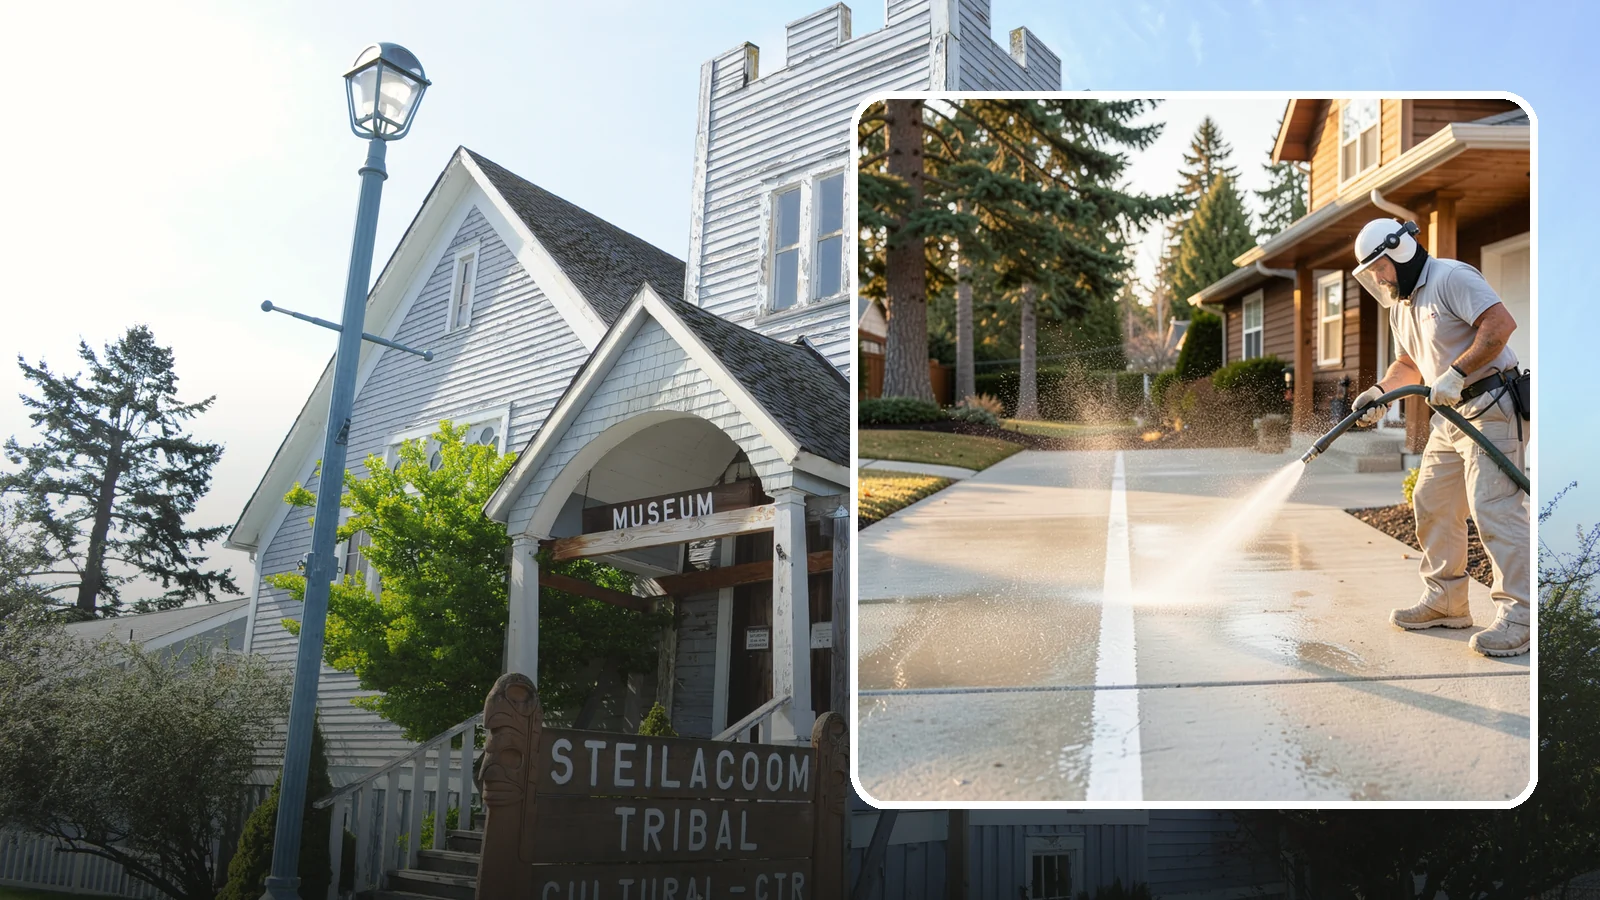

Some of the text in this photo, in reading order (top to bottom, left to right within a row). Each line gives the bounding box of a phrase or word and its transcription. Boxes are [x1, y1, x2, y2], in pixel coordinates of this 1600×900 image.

[613, 492, 714, 531] MUSEUM
[551, 738, 810, 793] STEILACOOM
[615, 806, 758, 852] TRIBAL
